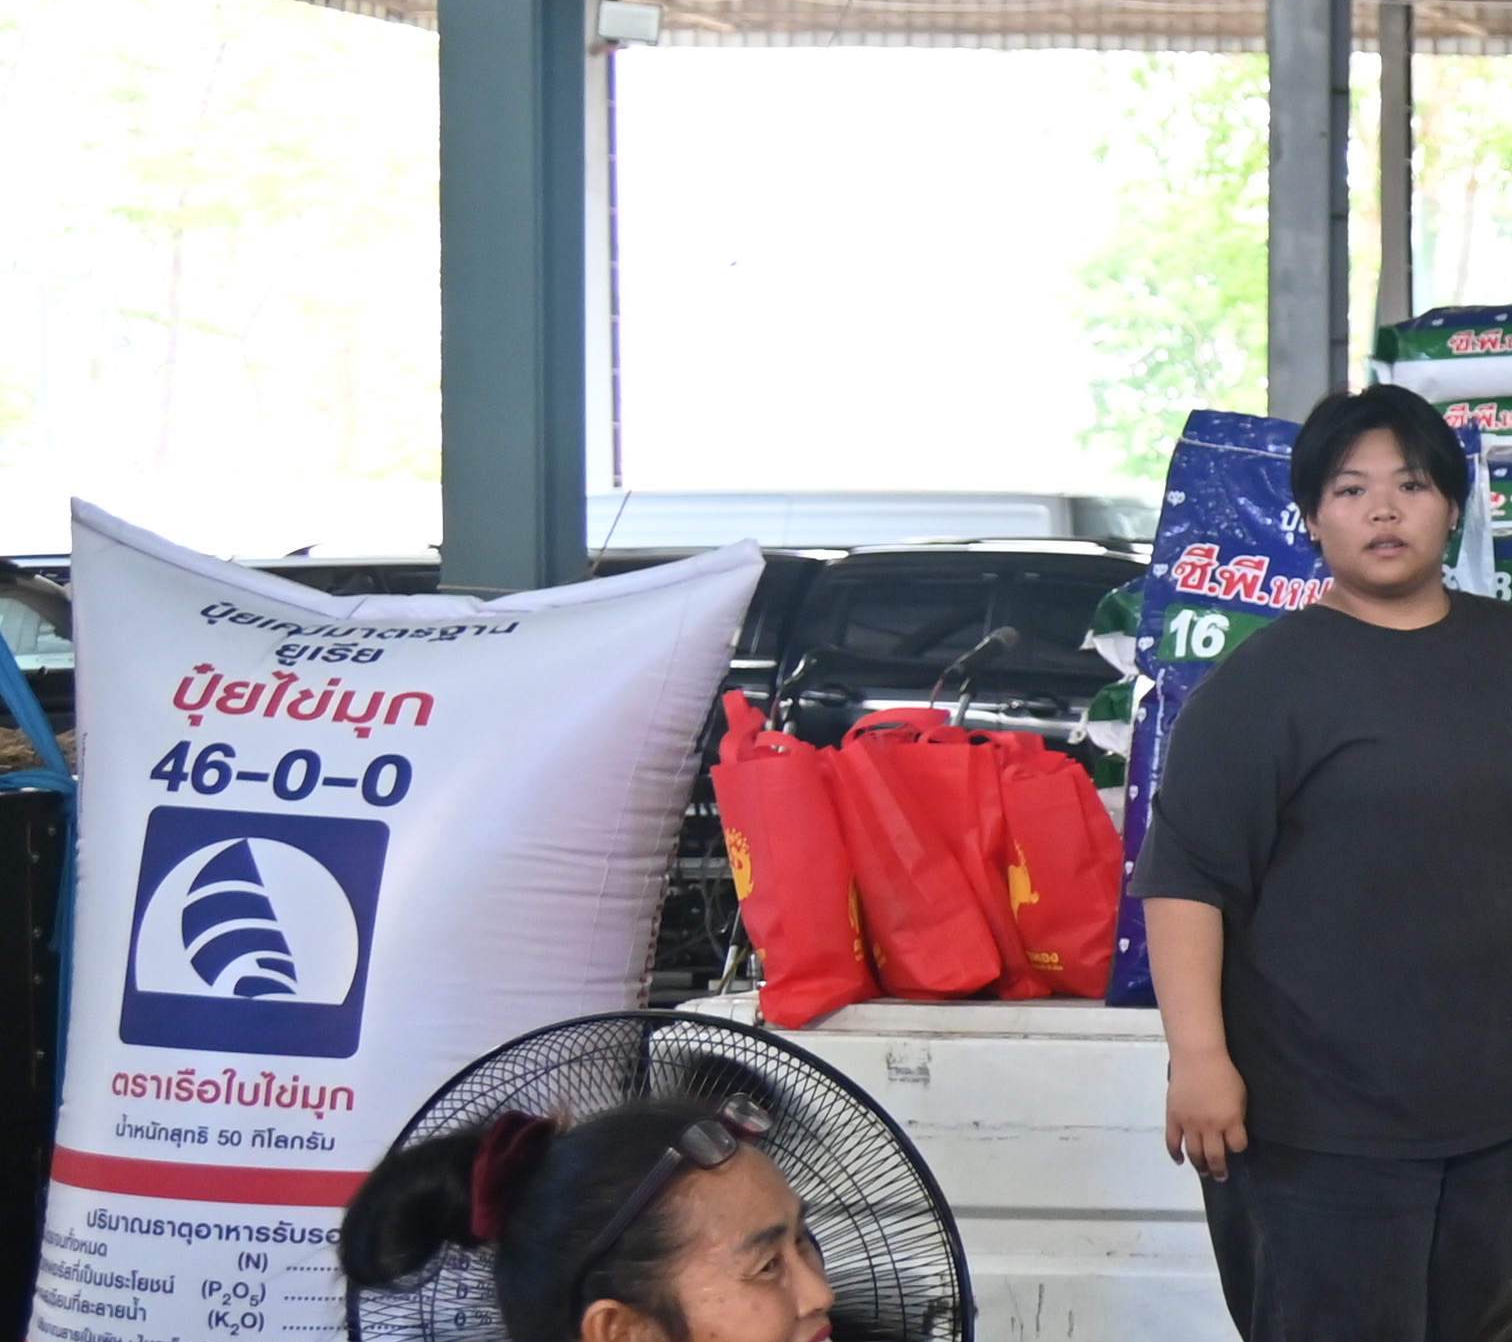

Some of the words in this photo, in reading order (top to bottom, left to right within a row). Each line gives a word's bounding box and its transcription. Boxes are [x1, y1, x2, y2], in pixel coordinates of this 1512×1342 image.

[275, 642, 384, 666] ยูเรีย
[173, 663, 435, 738] ปุ๋ยไข่มุก
[150, 740, 412, 807] 46-0-0
[112, 1068, 355, 1120] ตราเรือใบไข่มุก
[115, 1114, 209, 1149] น้ำหนักสุทธิ
[217, 1130, 242, 1147] 50
[251, 1128, 335, 1151] กิโลกรัม
[86, 1208, 341, 1246] ปริมาณธาตุอาหารรับรอ
[238, 1252, 268, 1274] (N)
